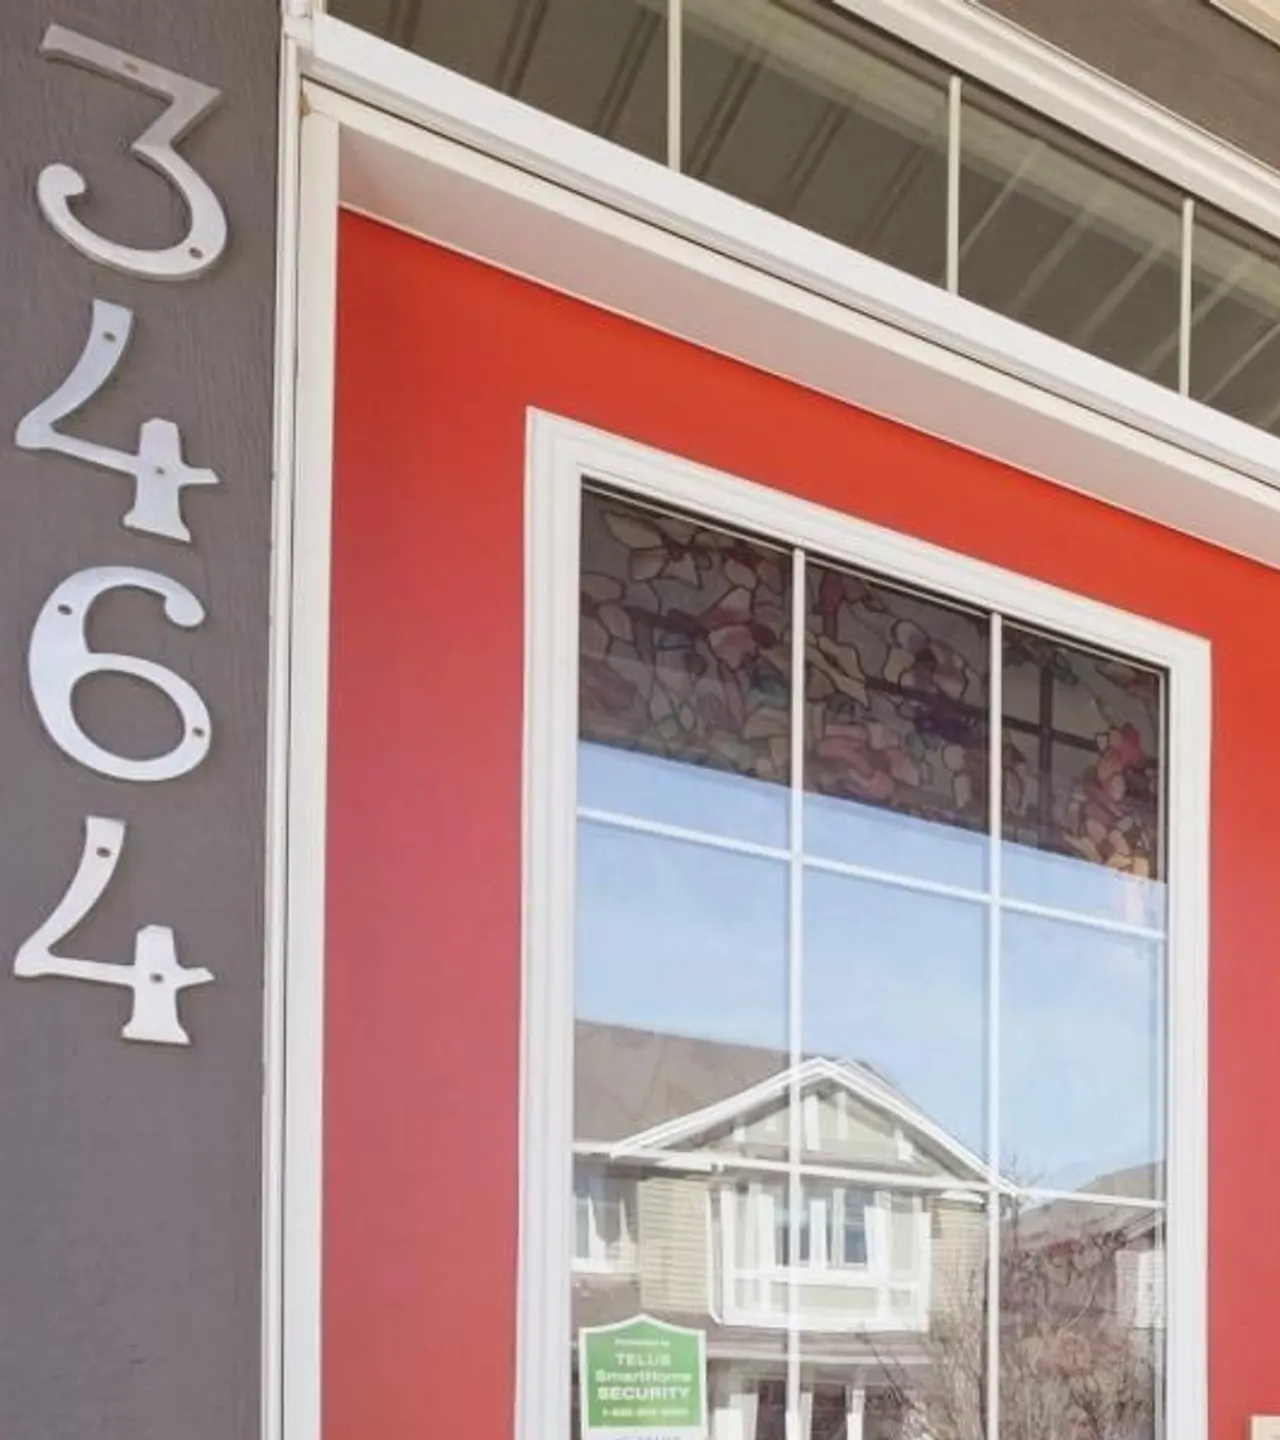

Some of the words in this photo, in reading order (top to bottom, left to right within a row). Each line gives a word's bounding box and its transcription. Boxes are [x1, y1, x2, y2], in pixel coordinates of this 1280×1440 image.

[15, 22, 228, 1045] 3464
[614, 1353, 672, 1366] TELUS
[597, 1386, 692, 1400] SECURITY
